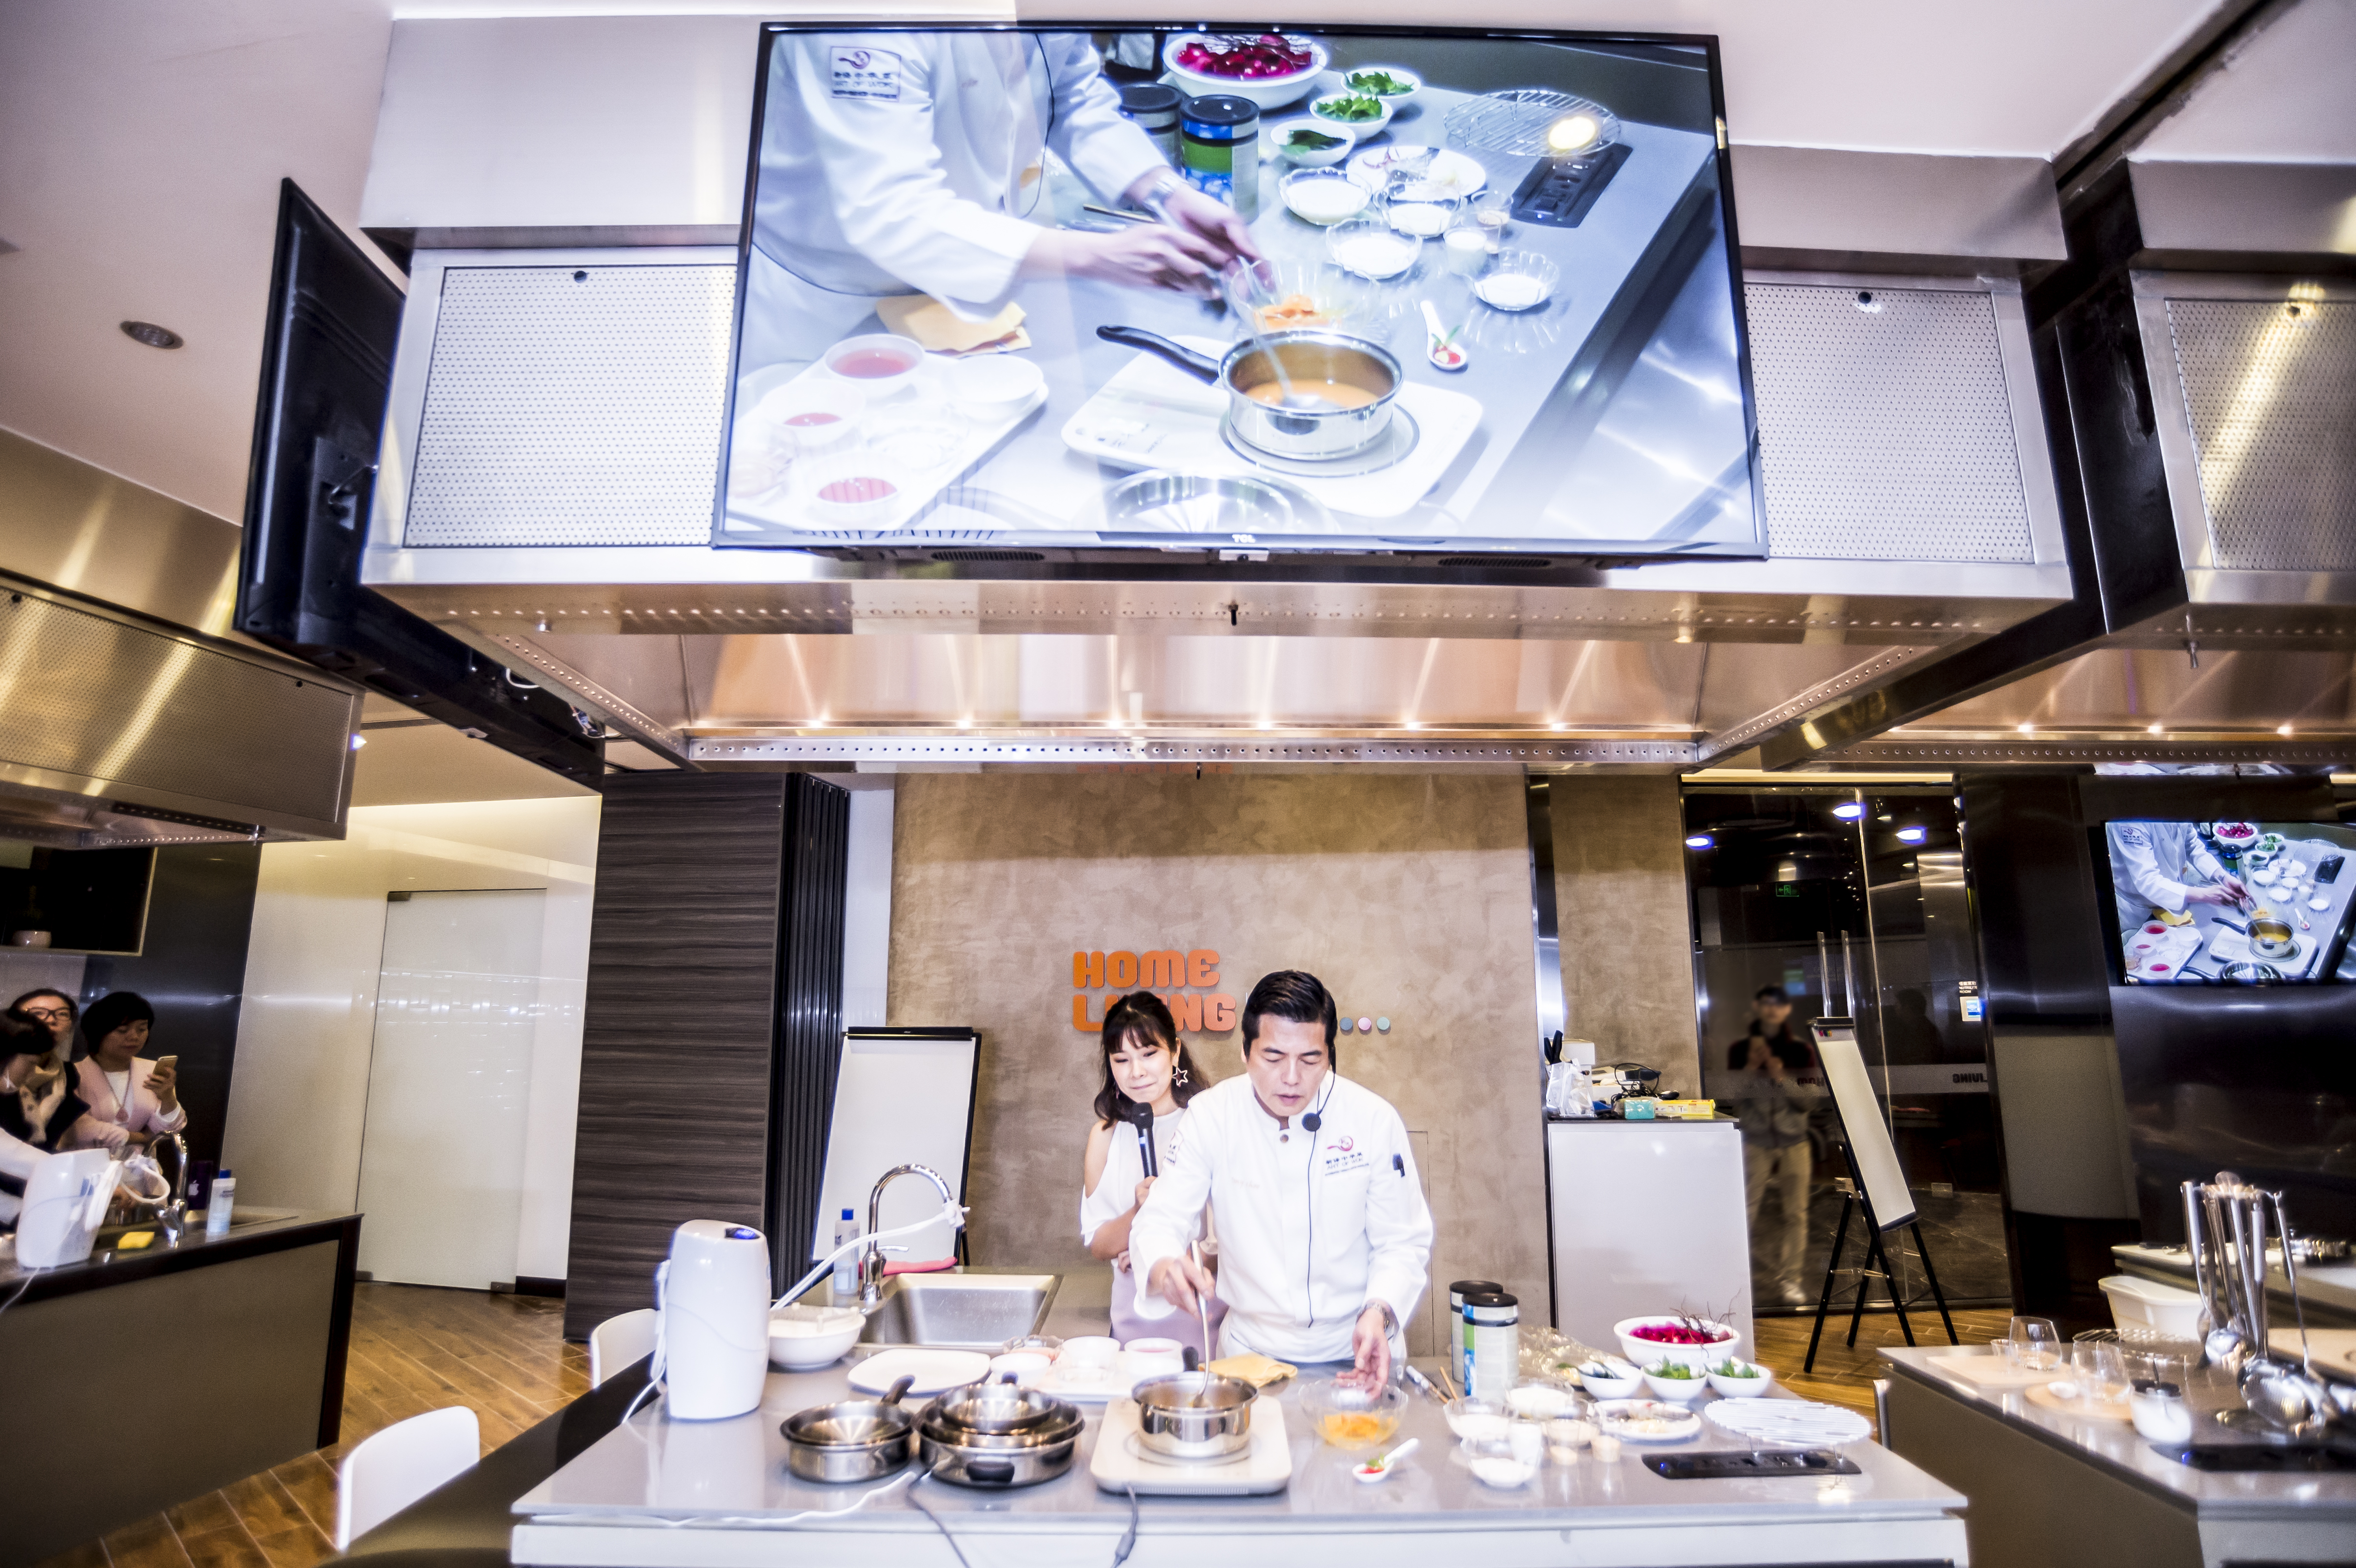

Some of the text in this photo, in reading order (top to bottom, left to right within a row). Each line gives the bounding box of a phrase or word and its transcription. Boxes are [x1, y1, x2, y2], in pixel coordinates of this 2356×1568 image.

[1232, 534, 1255, 543] TCL
[1073, 949, 1220, 988] HOME
[1073, 993, 1236, 1032] LNG
